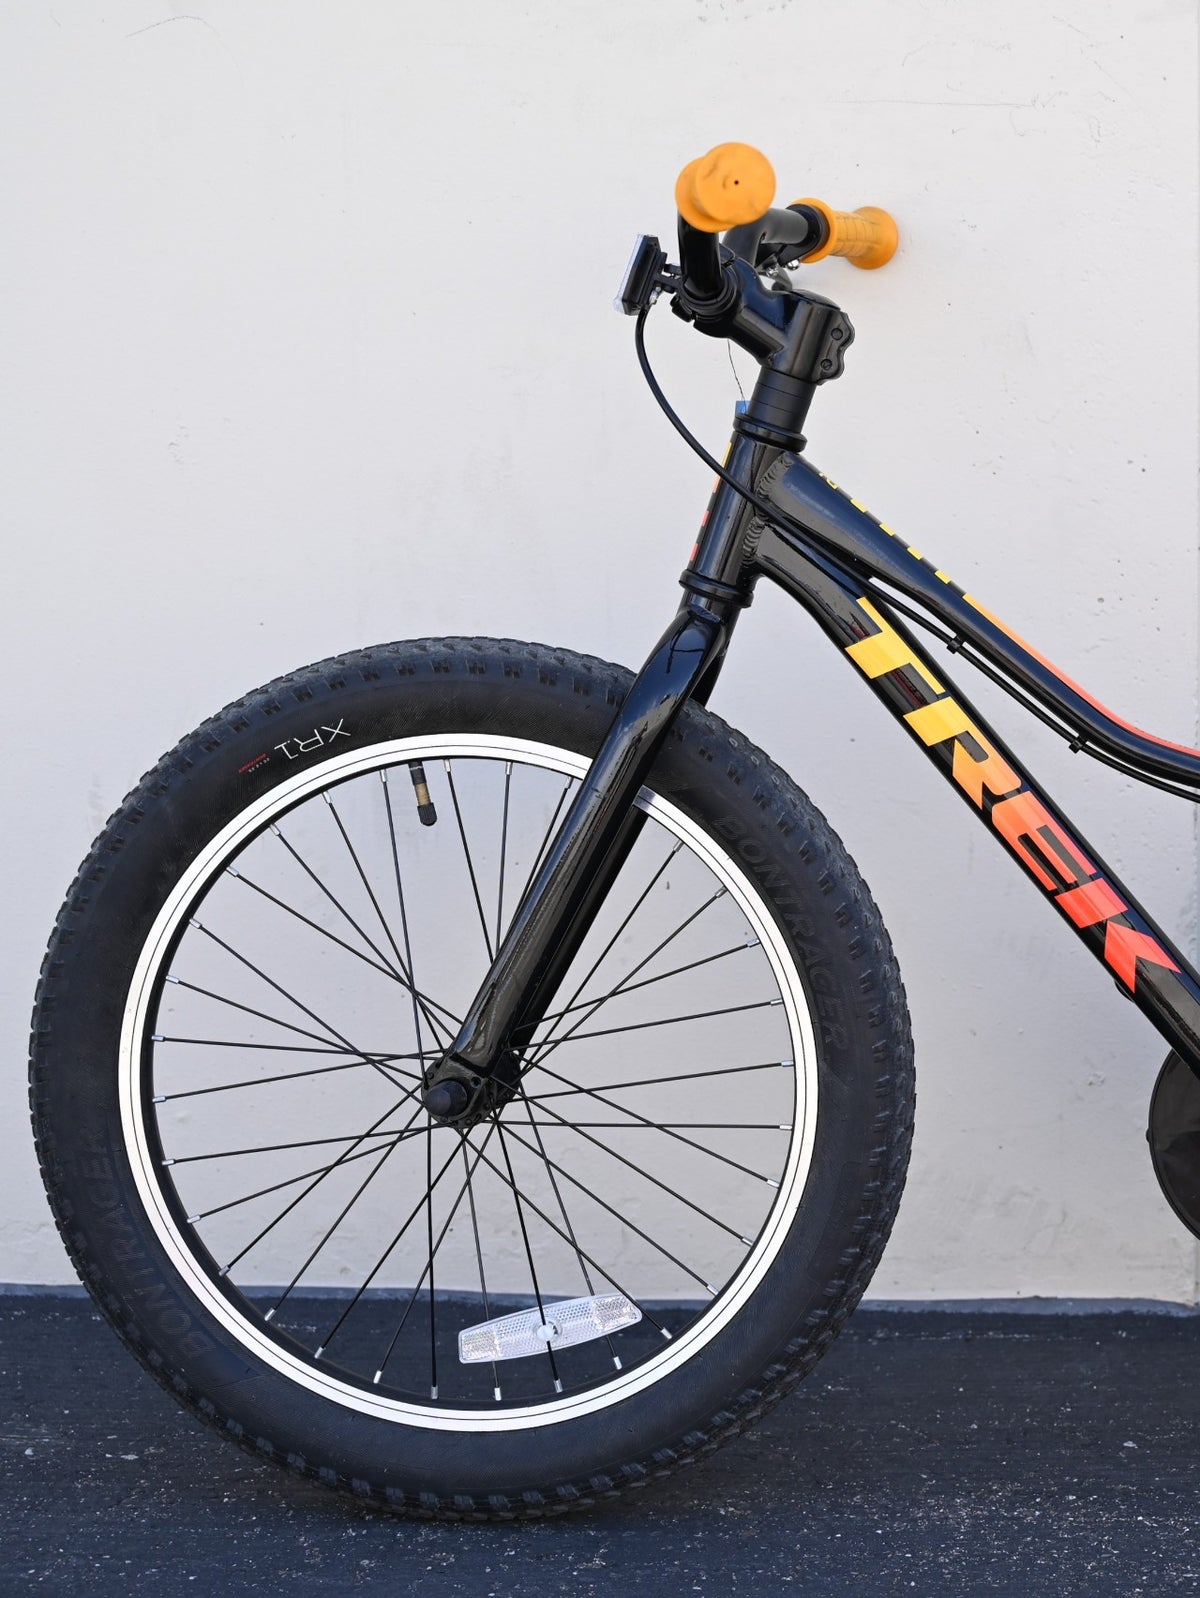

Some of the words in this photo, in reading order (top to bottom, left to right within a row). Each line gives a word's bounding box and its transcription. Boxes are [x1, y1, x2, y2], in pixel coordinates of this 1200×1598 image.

[273, 718, 351, 759] XR1
[845, 596, 1181, 992] TREK
[715, 813, 848, 1045] BONTRAGER
